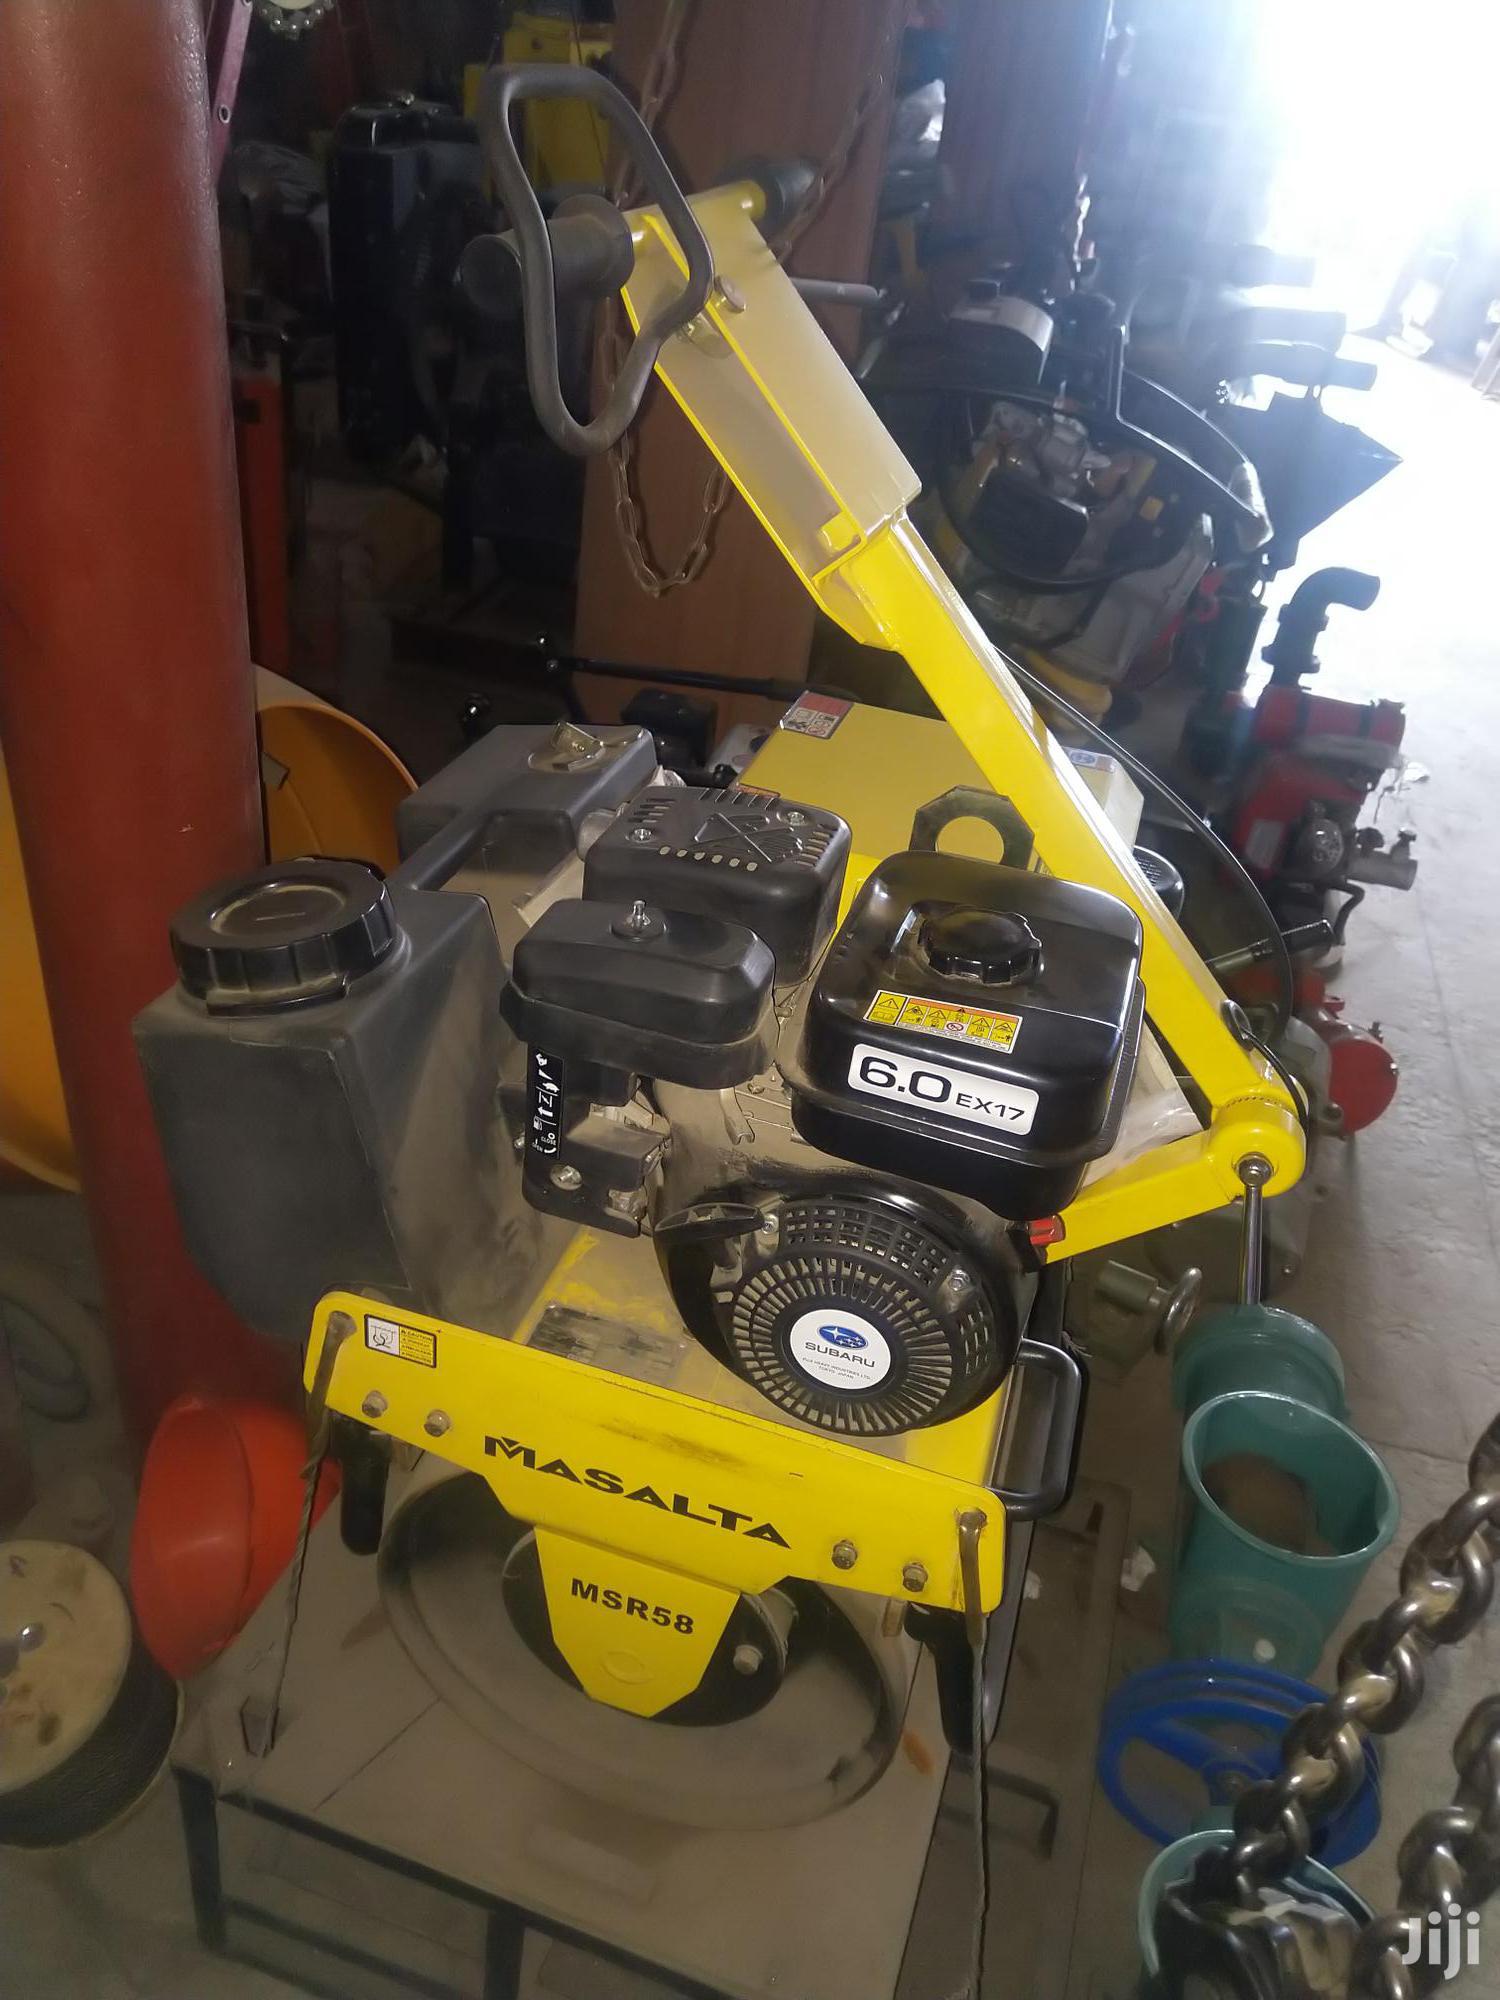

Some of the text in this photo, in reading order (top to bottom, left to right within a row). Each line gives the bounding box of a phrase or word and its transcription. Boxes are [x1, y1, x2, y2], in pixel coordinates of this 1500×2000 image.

[860, 1056, 1025, 1121] 6.0 EX17
[541, 1135, 556, 1145] CLOSE
[805, 1341, 876, 1368] SUBARU
[484, 1435, 792, 1550] MASALTA
[571, 1578, 695, 1636] MSR58
